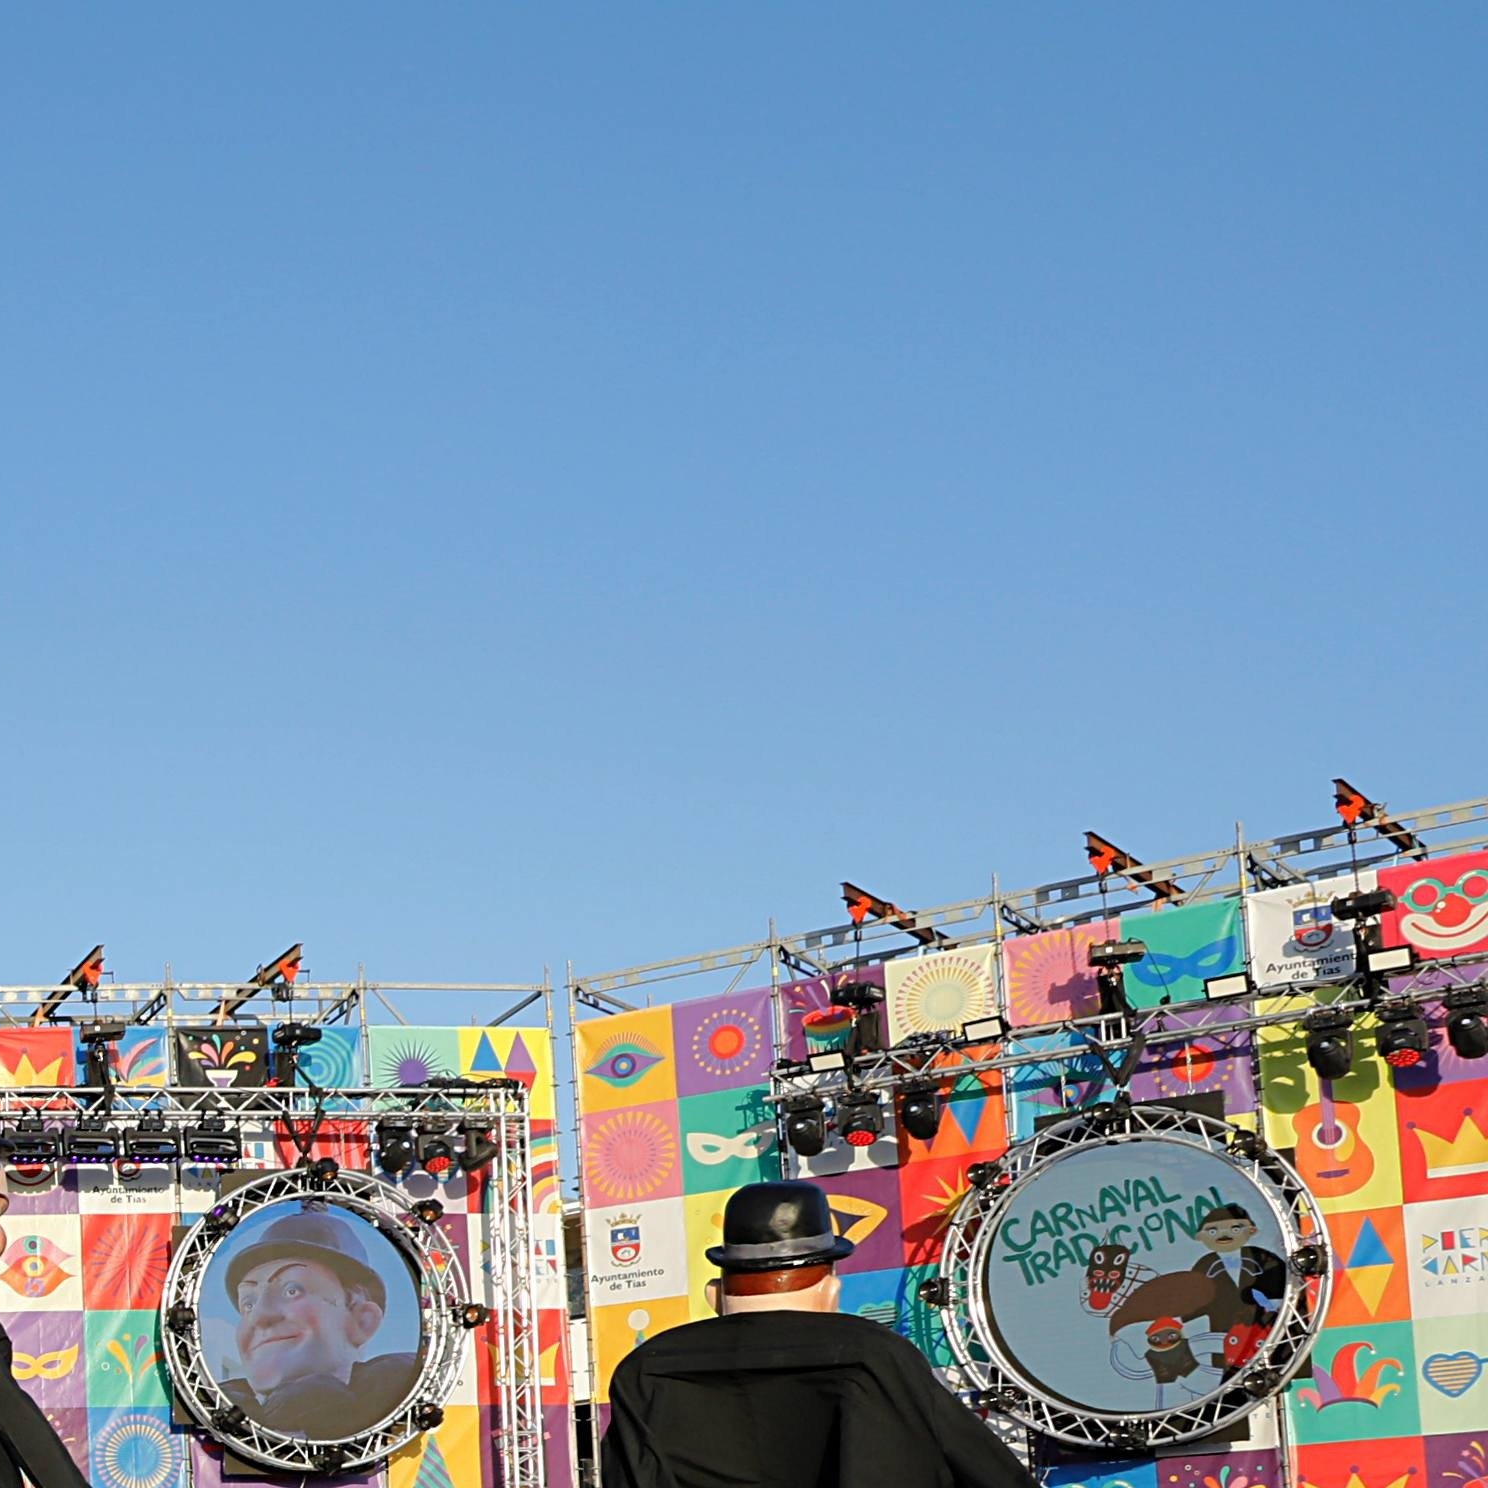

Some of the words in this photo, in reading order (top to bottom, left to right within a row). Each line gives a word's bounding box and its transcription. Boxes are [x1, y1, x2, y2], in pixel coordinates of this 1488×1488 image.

[1266, 953, 1356, 974] Ayuntamient
[1291, 970, 1308, 980] de
[110, 1194, 124, 1204] de
[1000, 1175, 1181, 1252] CARNAVAL
[591, 1268, 664, 1285] Ayuntamiento
[609, 1280, 622, 1291] de
